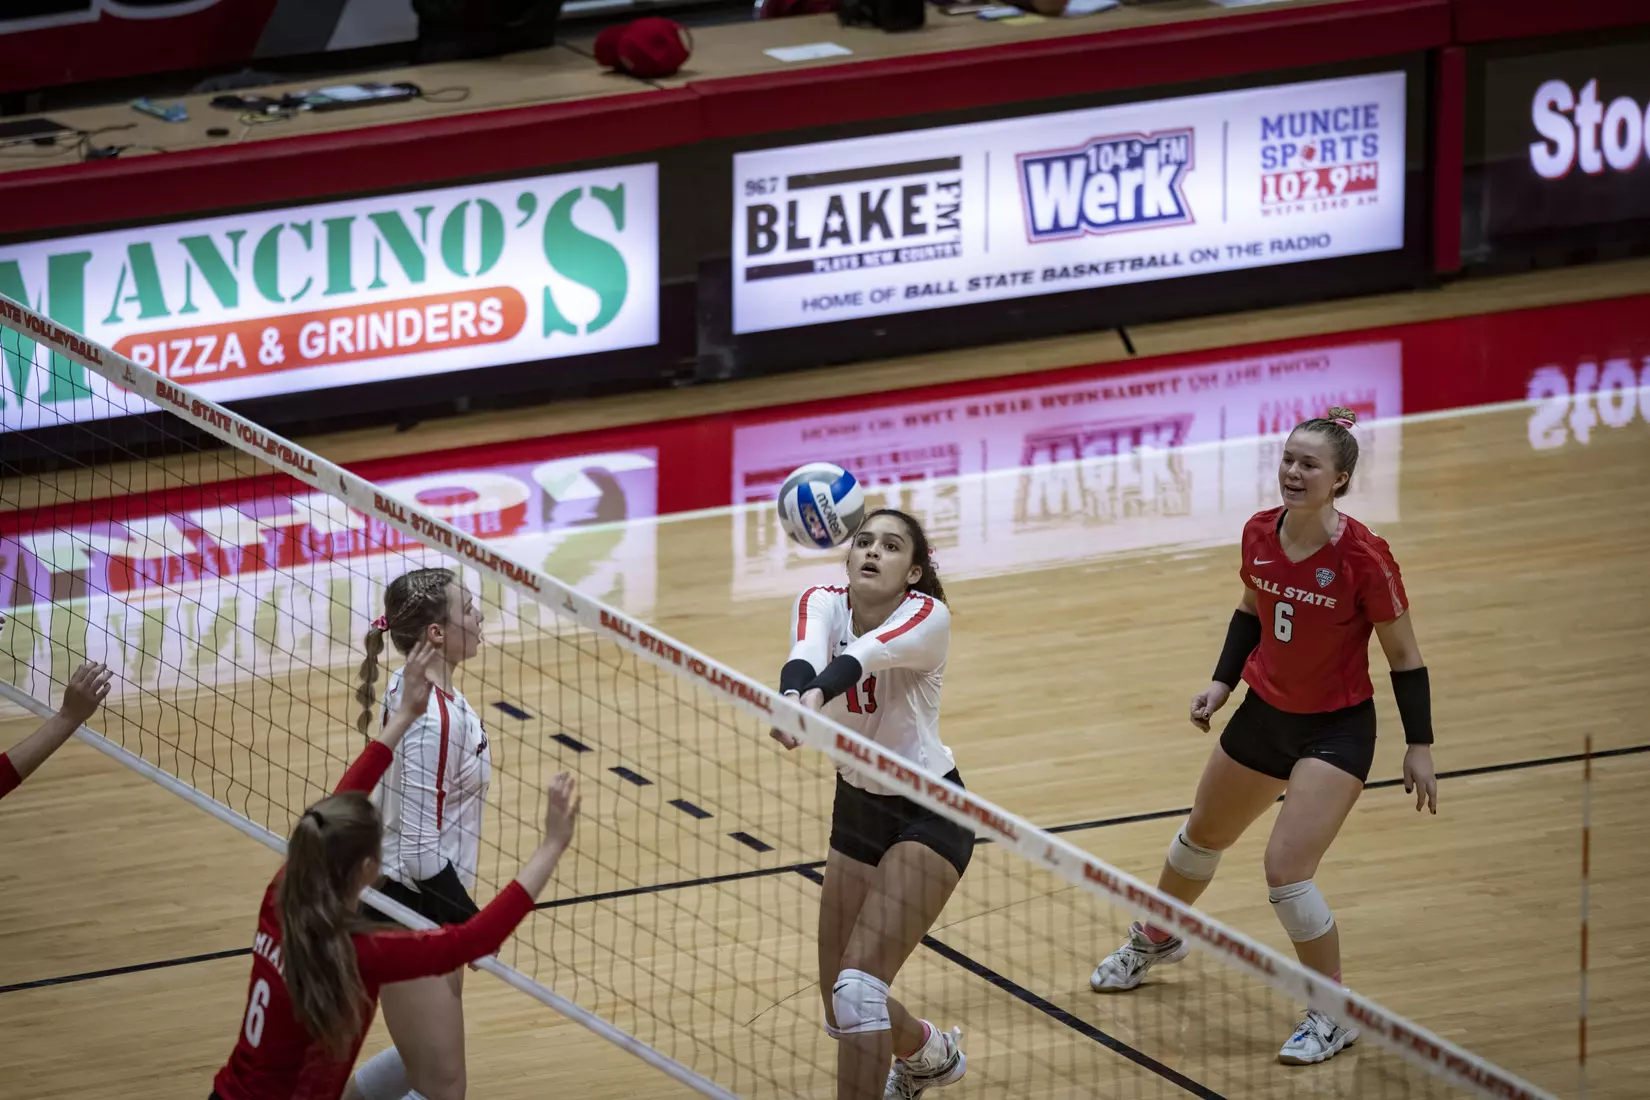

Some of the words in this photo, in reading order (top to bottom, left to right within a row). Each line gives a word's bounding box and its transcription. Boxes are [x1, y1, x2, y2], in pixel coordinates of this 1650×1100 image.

[1260, 104, 1379, 141] MUNCIE
[1529, 78, 1650, 180] Sto
[746, 183, 928, 257] BLAKE
[936, 178, 962, 234] FM
[1026, 147, 1181, 231] Werk
[802, 294, 864, 313] HOME
[869, 288, 896, 304] OF
[904, 281, 959, 300] BALL
[967, 269, 1034, 291] STATE
[1041, 252, 1183, 282] BASKETBALL
[1190, 246, 1220, 263] ON
[1227, 243, 1264, 260] THE
[1270, 232, 1332, 254] RADIO
[24, 311, 103, 367] VOLLEYBALL
[130, 331, 248, 378] PIZZA
[257, 327, 286, 365] &
[299, 297, 504, 357] GRINDERS
[155, 380, 190, 412] BALL
[191, 401, 231, 433] STATE
[235, 419, 318, 478] VOLLEYBALL
[373, 492, 408, 525] BALL
[411, 512, 453, 549] STATE
[454, 534, 541, 593] VOLLEYBALL
[815, 492, 842, 539] molten
[1249, 574, 1281, 596] BALL
[1283, 586, 1338, 609] STATE
[1274, 600, 1295, 643] 6
[599, 609, 637, 643] BALL
[638, 630, 682, 666] STATE
[684, 653, 774, 715] VOLLEYBALL
[844, 673, 878, 715] 13
[253, 931, 285, 975] MIA
[245, 978, 271, 1049] 6
